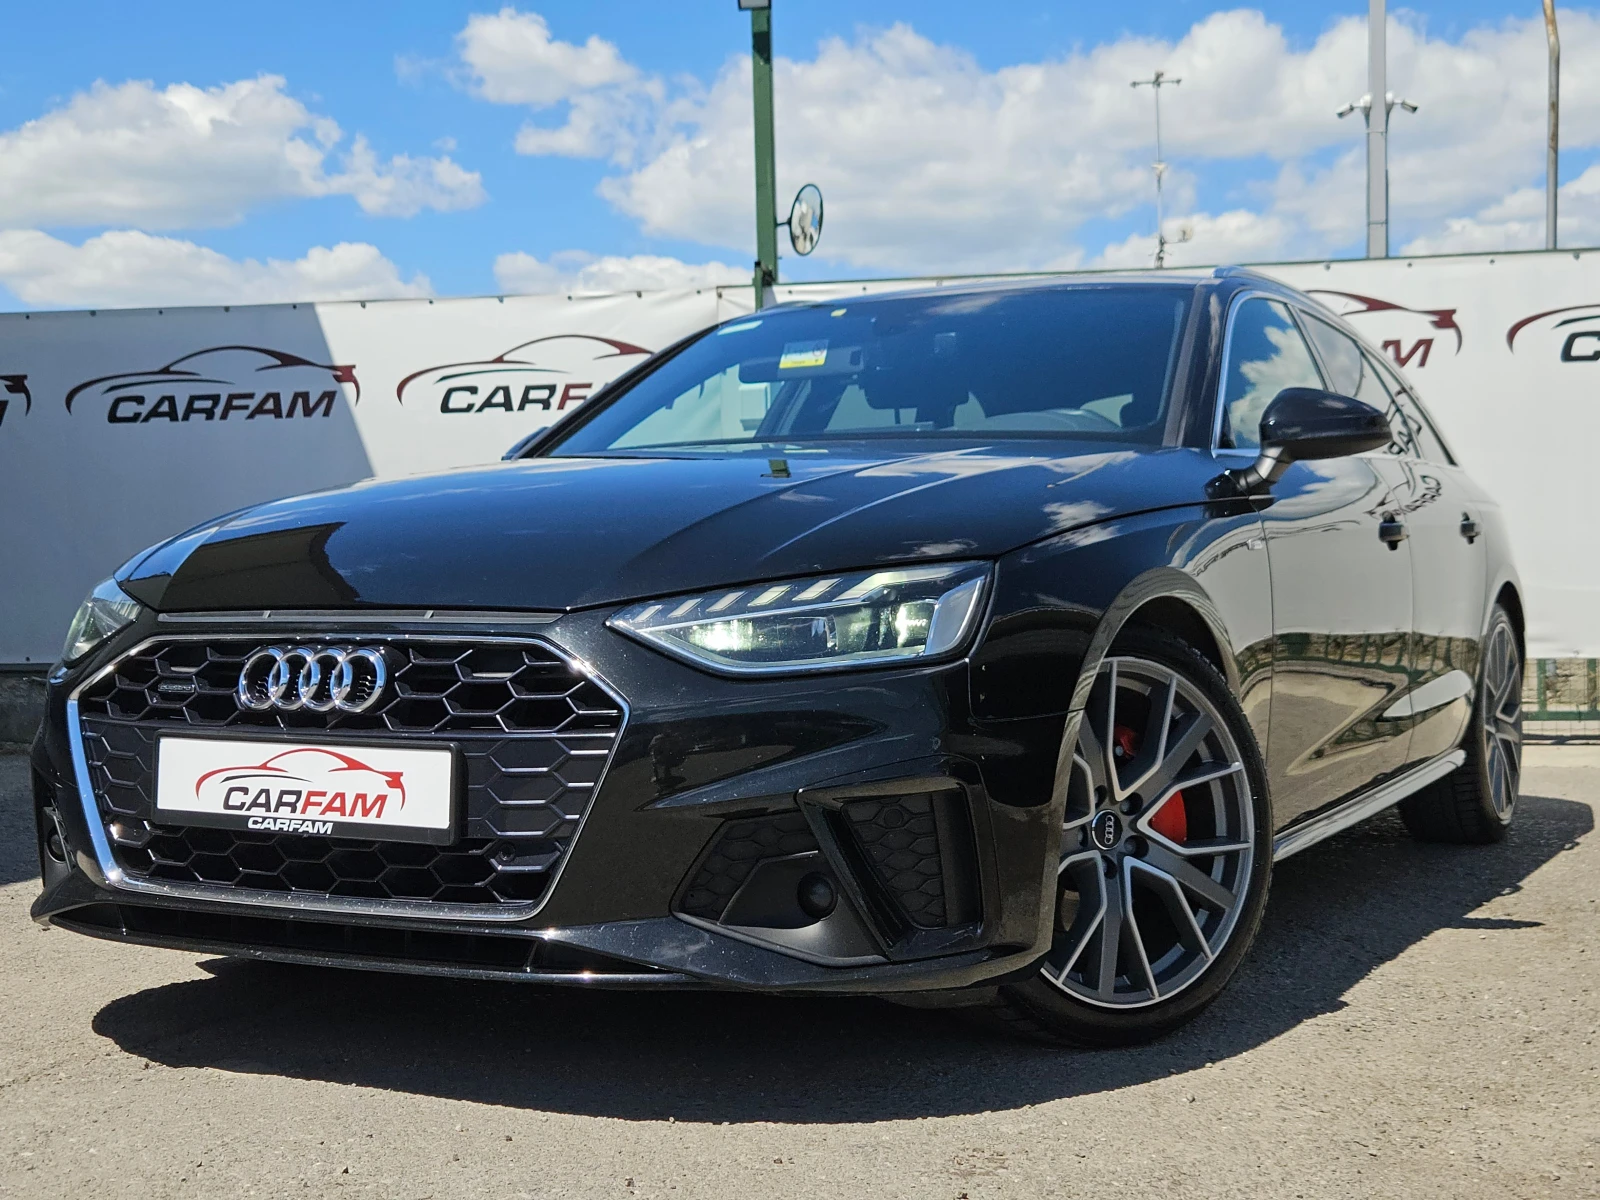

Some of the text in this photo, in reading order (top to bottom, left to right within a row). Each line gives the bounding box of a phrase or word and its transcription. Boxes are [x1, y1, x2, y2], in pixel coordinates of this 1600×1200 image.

[107, 390, 338, 424] CARFAM
[440, 382, 594, 414] CARF
[222, 786, 389, 819] CARFAM
[247, 816, 334, 835] CARFAM
